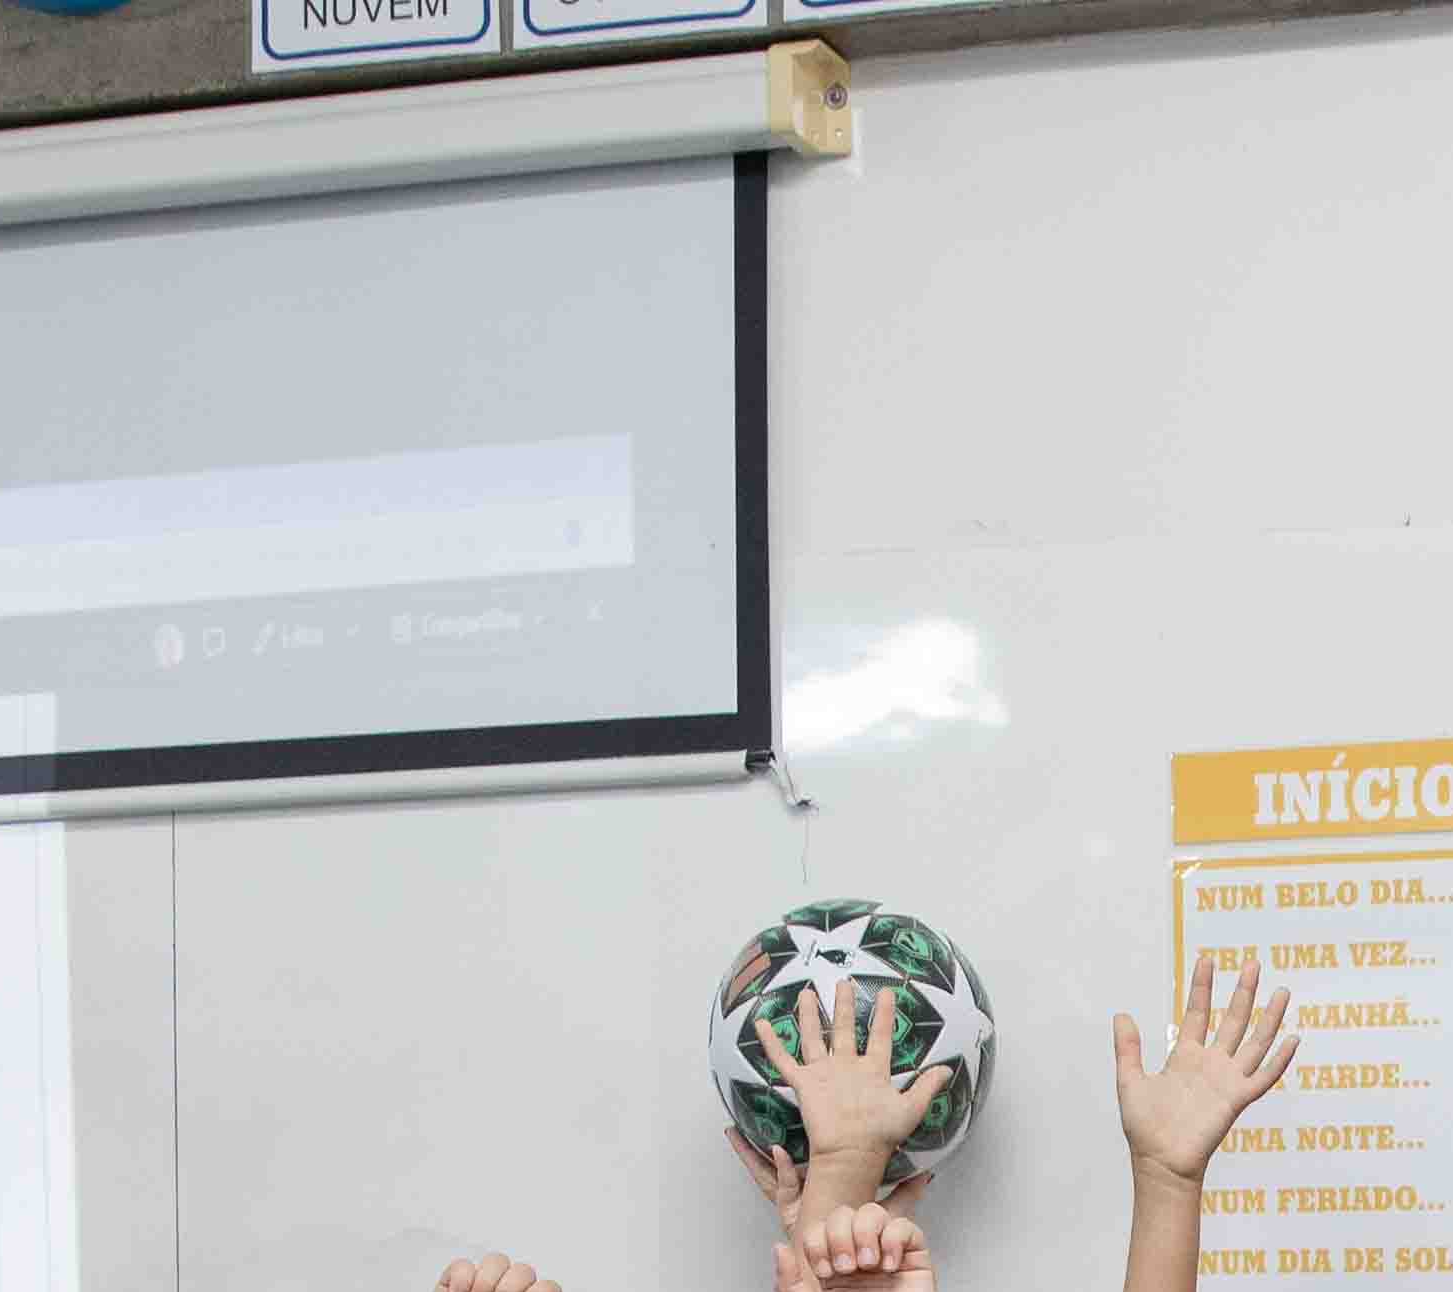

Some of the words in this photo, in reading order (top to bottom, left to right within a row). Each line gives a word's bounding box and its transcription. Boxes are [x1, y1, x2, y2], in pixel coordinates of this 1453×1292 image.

[1196, 885, 1264, 912] NUM
[1275, 880, 1359, 910] BELO
[1271, 942, 1338, 970] UMA
[1349, 939, 1436, 967] VEZ...
[1297, 995, 1441, 1029] MANHÃ...
[1297, 1063, 1430, 1090] TARDE...
[1296, 1124, 1425, 1152] NOITE...
[1199, 1189, 1267, 1217] NUM
[1277, 1185, 1445, 1214] FERIADO...
[1198, 1250, 1267, 1276] NUM
[1277, 1248, 1333, 1274] DIA
[1343, 1247, 1384, 1273] DE
